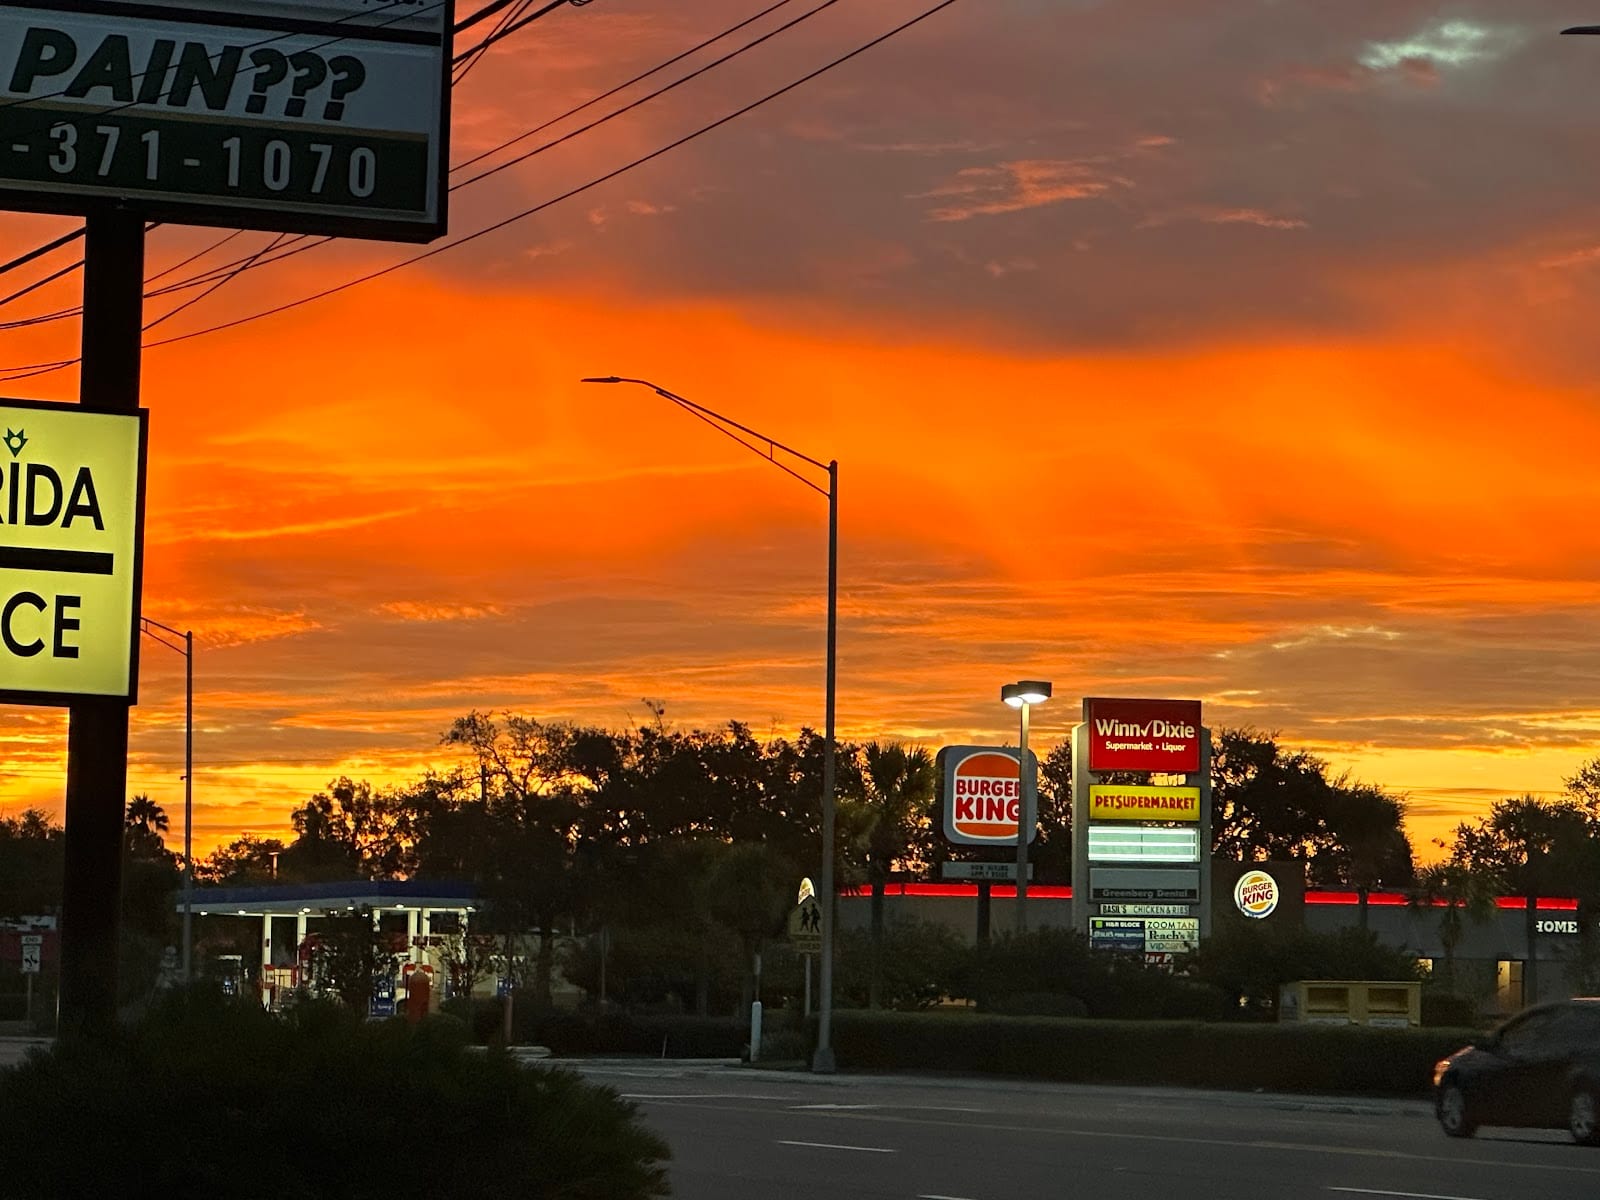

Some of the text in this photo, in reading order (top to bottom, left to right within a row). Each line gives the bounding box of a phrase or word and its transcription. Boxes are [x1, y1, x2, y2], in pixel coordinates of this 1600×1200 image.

[8, 27, 366, 121] PAIN???
[0, 462, 104, 530] IDA
[1, 591, 82, 658] CE
[1095, 719, 1195, 738] Winn Dixie
[1105, 741, 1186, 753] Supermarket Liquor
[1102, 889, 1188, 899] Greenberg Dental
[1242, 882, 1273, 895] BURGER
[1243, 890, 1273, 905] KING
[1102, 905, 1127, 914] BASIL'S
[1147, 921, 1195, 929] ZOOM TAN
[1149, 930, 1185, 940] Peach's
